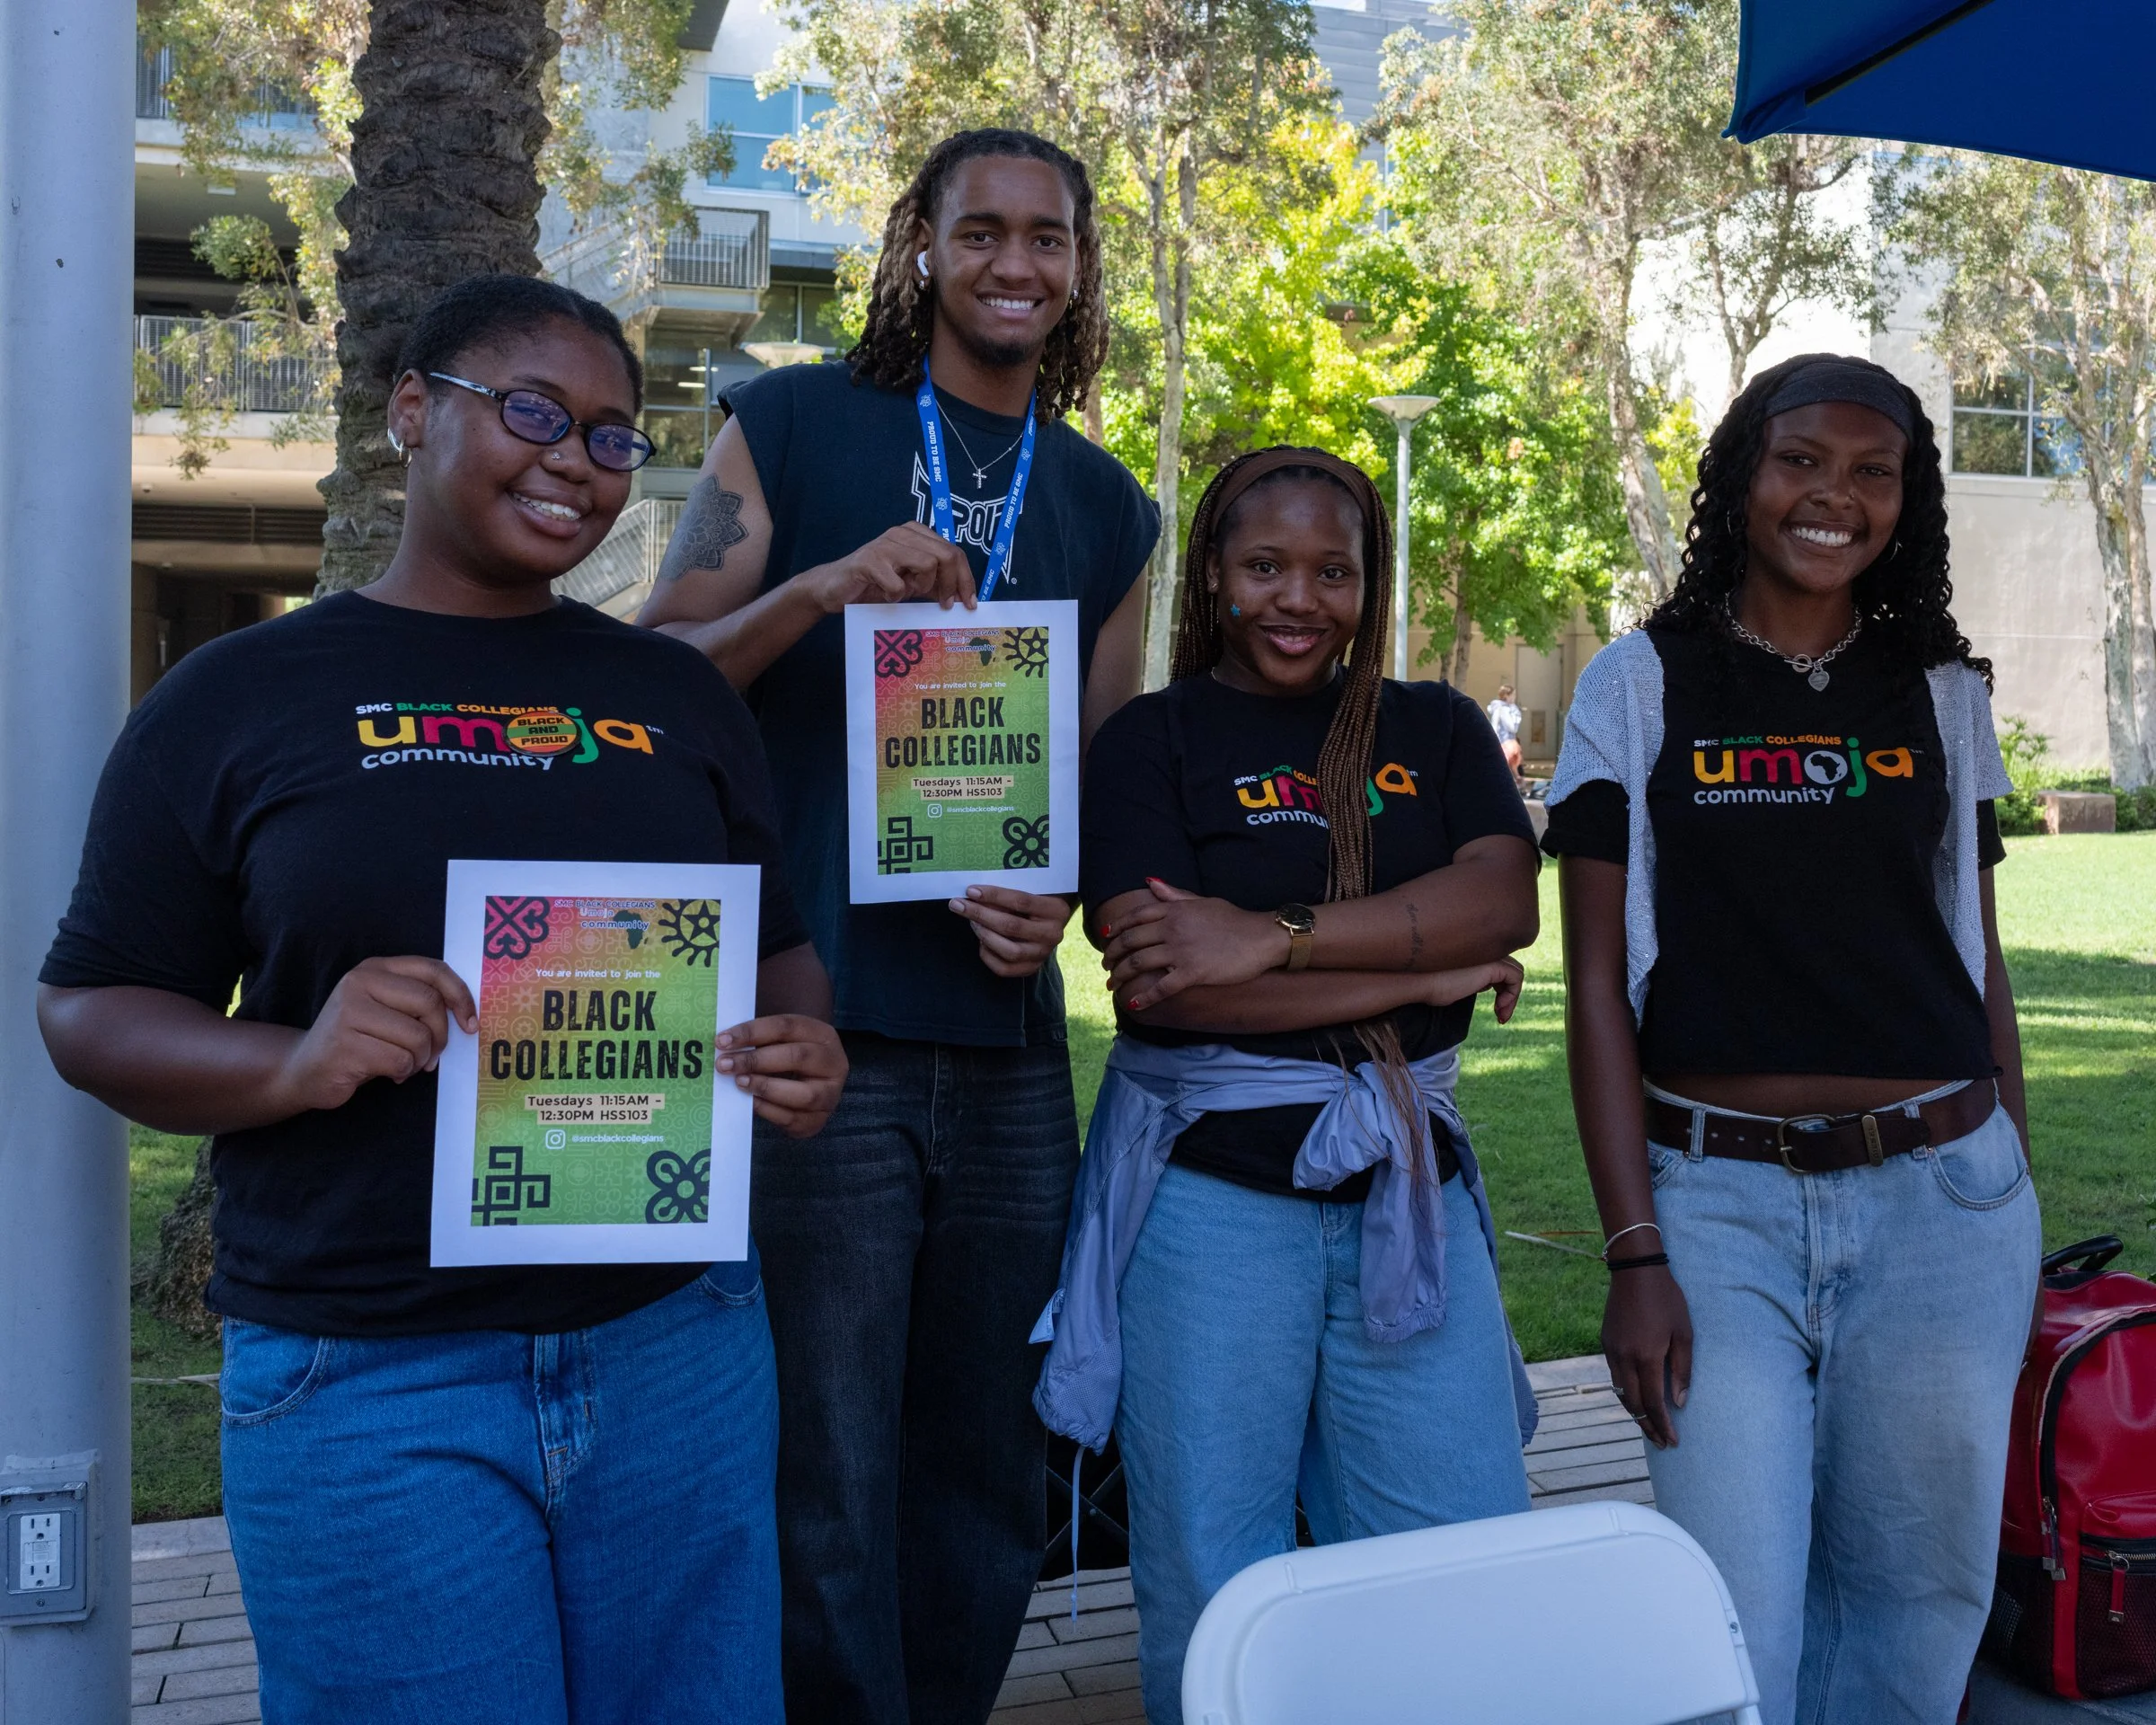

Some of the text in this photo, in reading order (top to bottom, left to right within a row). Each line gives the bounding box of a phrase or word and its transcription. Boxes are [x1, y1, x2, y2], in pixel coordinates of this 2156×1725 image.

[927, 420, 942, 482] PROUD TO BE SMC
[1003, 472, 1023, 529] PROUD TO BE SMC
[986, 568, 994, 585] SMC
[945, 643, 997, 653] community
[355, 703, 393, 714] SMC
[395, 703, 454, 712] BLACK
[922, 696, 1004, 730] BLACK
[517, 717, 565, 726] BLACK
[528, 726, 559, 735] AND
[521, 736, 568, 746] PROUD
[1693, 734, 1842, 747] SMC BLACK COLLEGIANS
[885, 732, 1041, 768] COLLEGIANS
[361, 748, 554, 771] community
[913, 777, 961, 788] Tuesdays
[966, 776, 1003, 786] 11:15AM
[1233, 775, 1258, 786] SMC
[1259, 765, 1293, 780] BLACK
[923, 788, 1002, 798] 12:30PM HSS103
[1693, 786, 1834, 805] community
[947, 805, 1015, 814] @smcblackcollegians
[554, 899, 656, 908] SMC BLACK COLLEGIANS
[580, 919, 649, 932] community
[535, 969, 553, 978] You
[575, 969, 606, 978] invited
[610, 970, 621, 978] to
[624, 969, 642, 979] join
[645, 969, 661, 978] the
[543, 990, 657, 1031] BLACK
[490, 1039, 703, 1081] COLLEGIANS
[528, 1095, 593, 1108] Tuesdays
[600, 1095, 649, 1105] 11:15AM
[541, 1110, 648, 1120] 12:30PM HSS103
[571, 1134, 664, 1145] @smcblackcollegians
